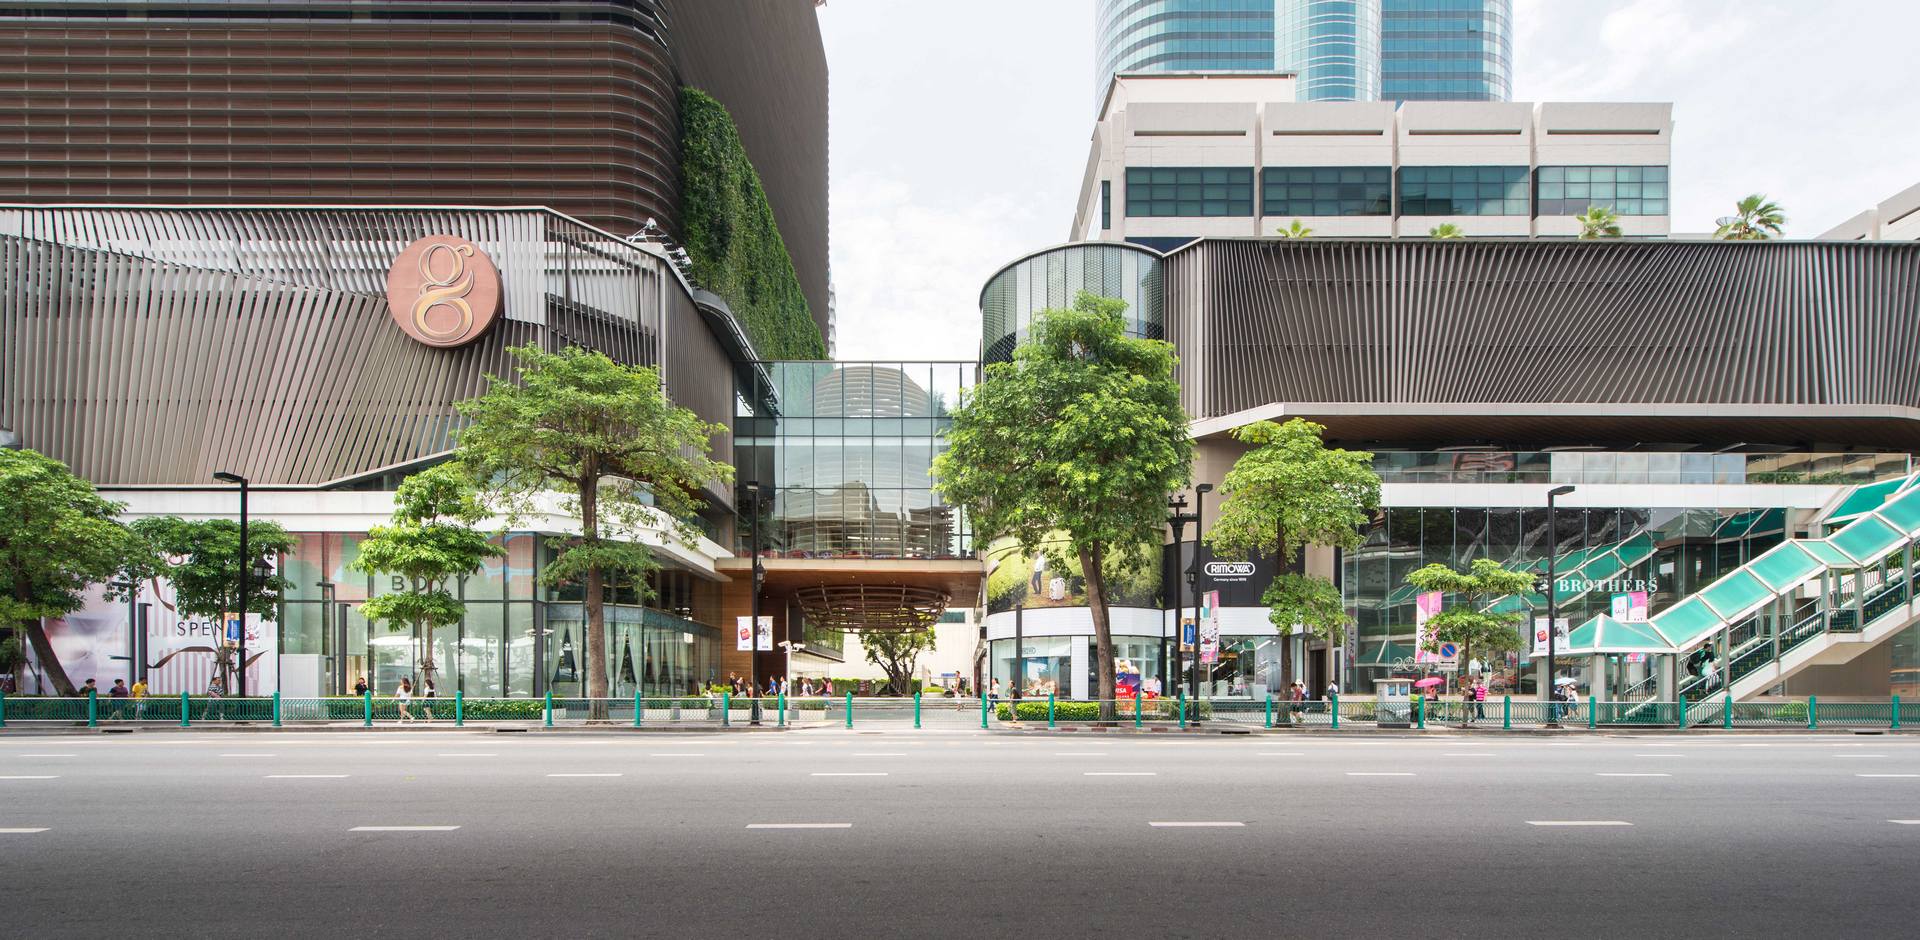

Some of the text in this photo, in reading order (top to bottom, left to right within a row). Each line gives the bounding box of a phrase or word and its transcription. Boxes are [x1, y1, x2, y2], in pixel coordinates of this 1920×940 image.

[410, 243, 475, 343] g
[1211, 564, 1248, 574] RIMOWA
[1559, 578, 1658, 592] BROTHERS
